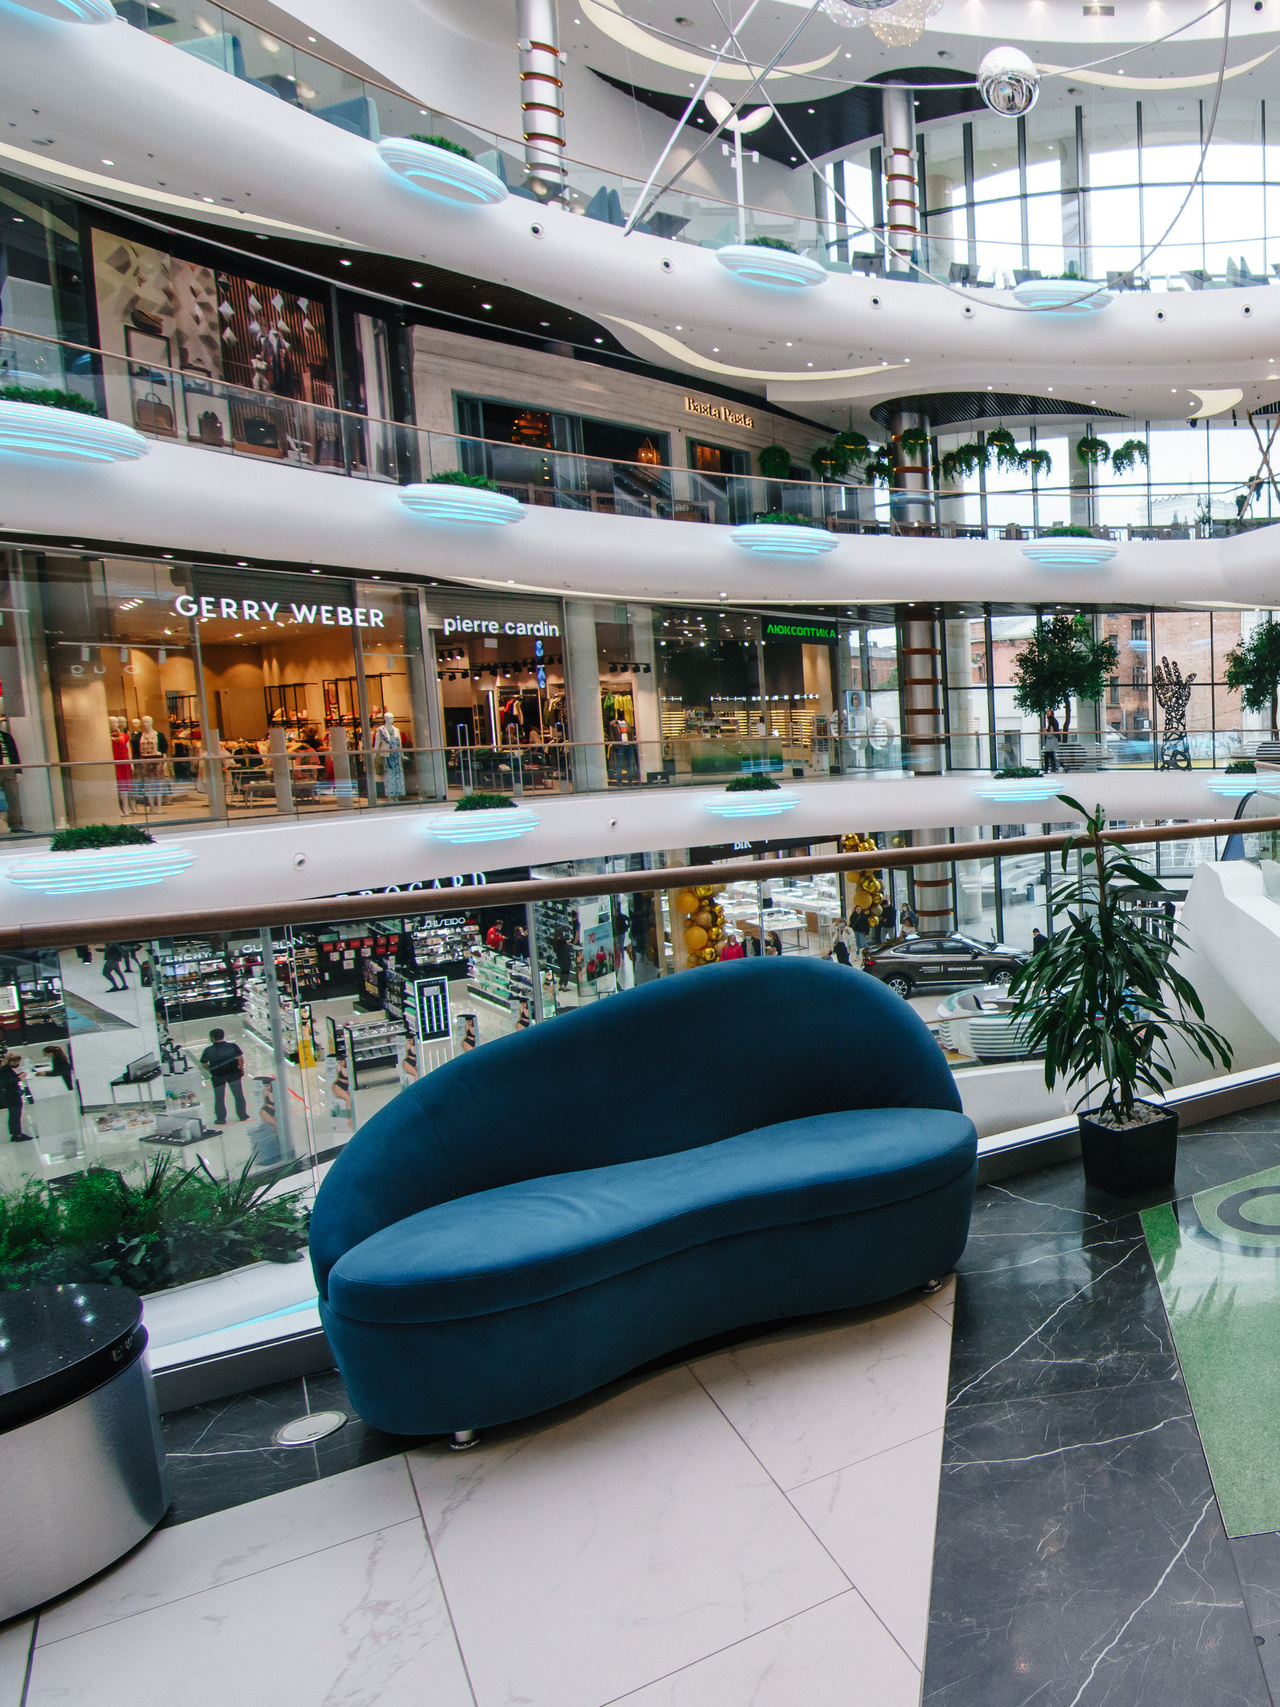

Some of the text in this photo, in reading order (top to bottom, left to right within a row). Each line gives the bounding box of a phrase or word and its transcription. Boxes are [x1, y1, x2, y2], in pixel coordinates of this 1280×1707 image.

[685, 396, 755, 429] Basta Pasta
[175, 595, 385, 628] GERRY WEBER
[443, 615, 560, 637] pierre cardin
[766, 623, 837, 639] ЛЮКСОПТИКА
[242, 936, 303, 953] GURLAN
